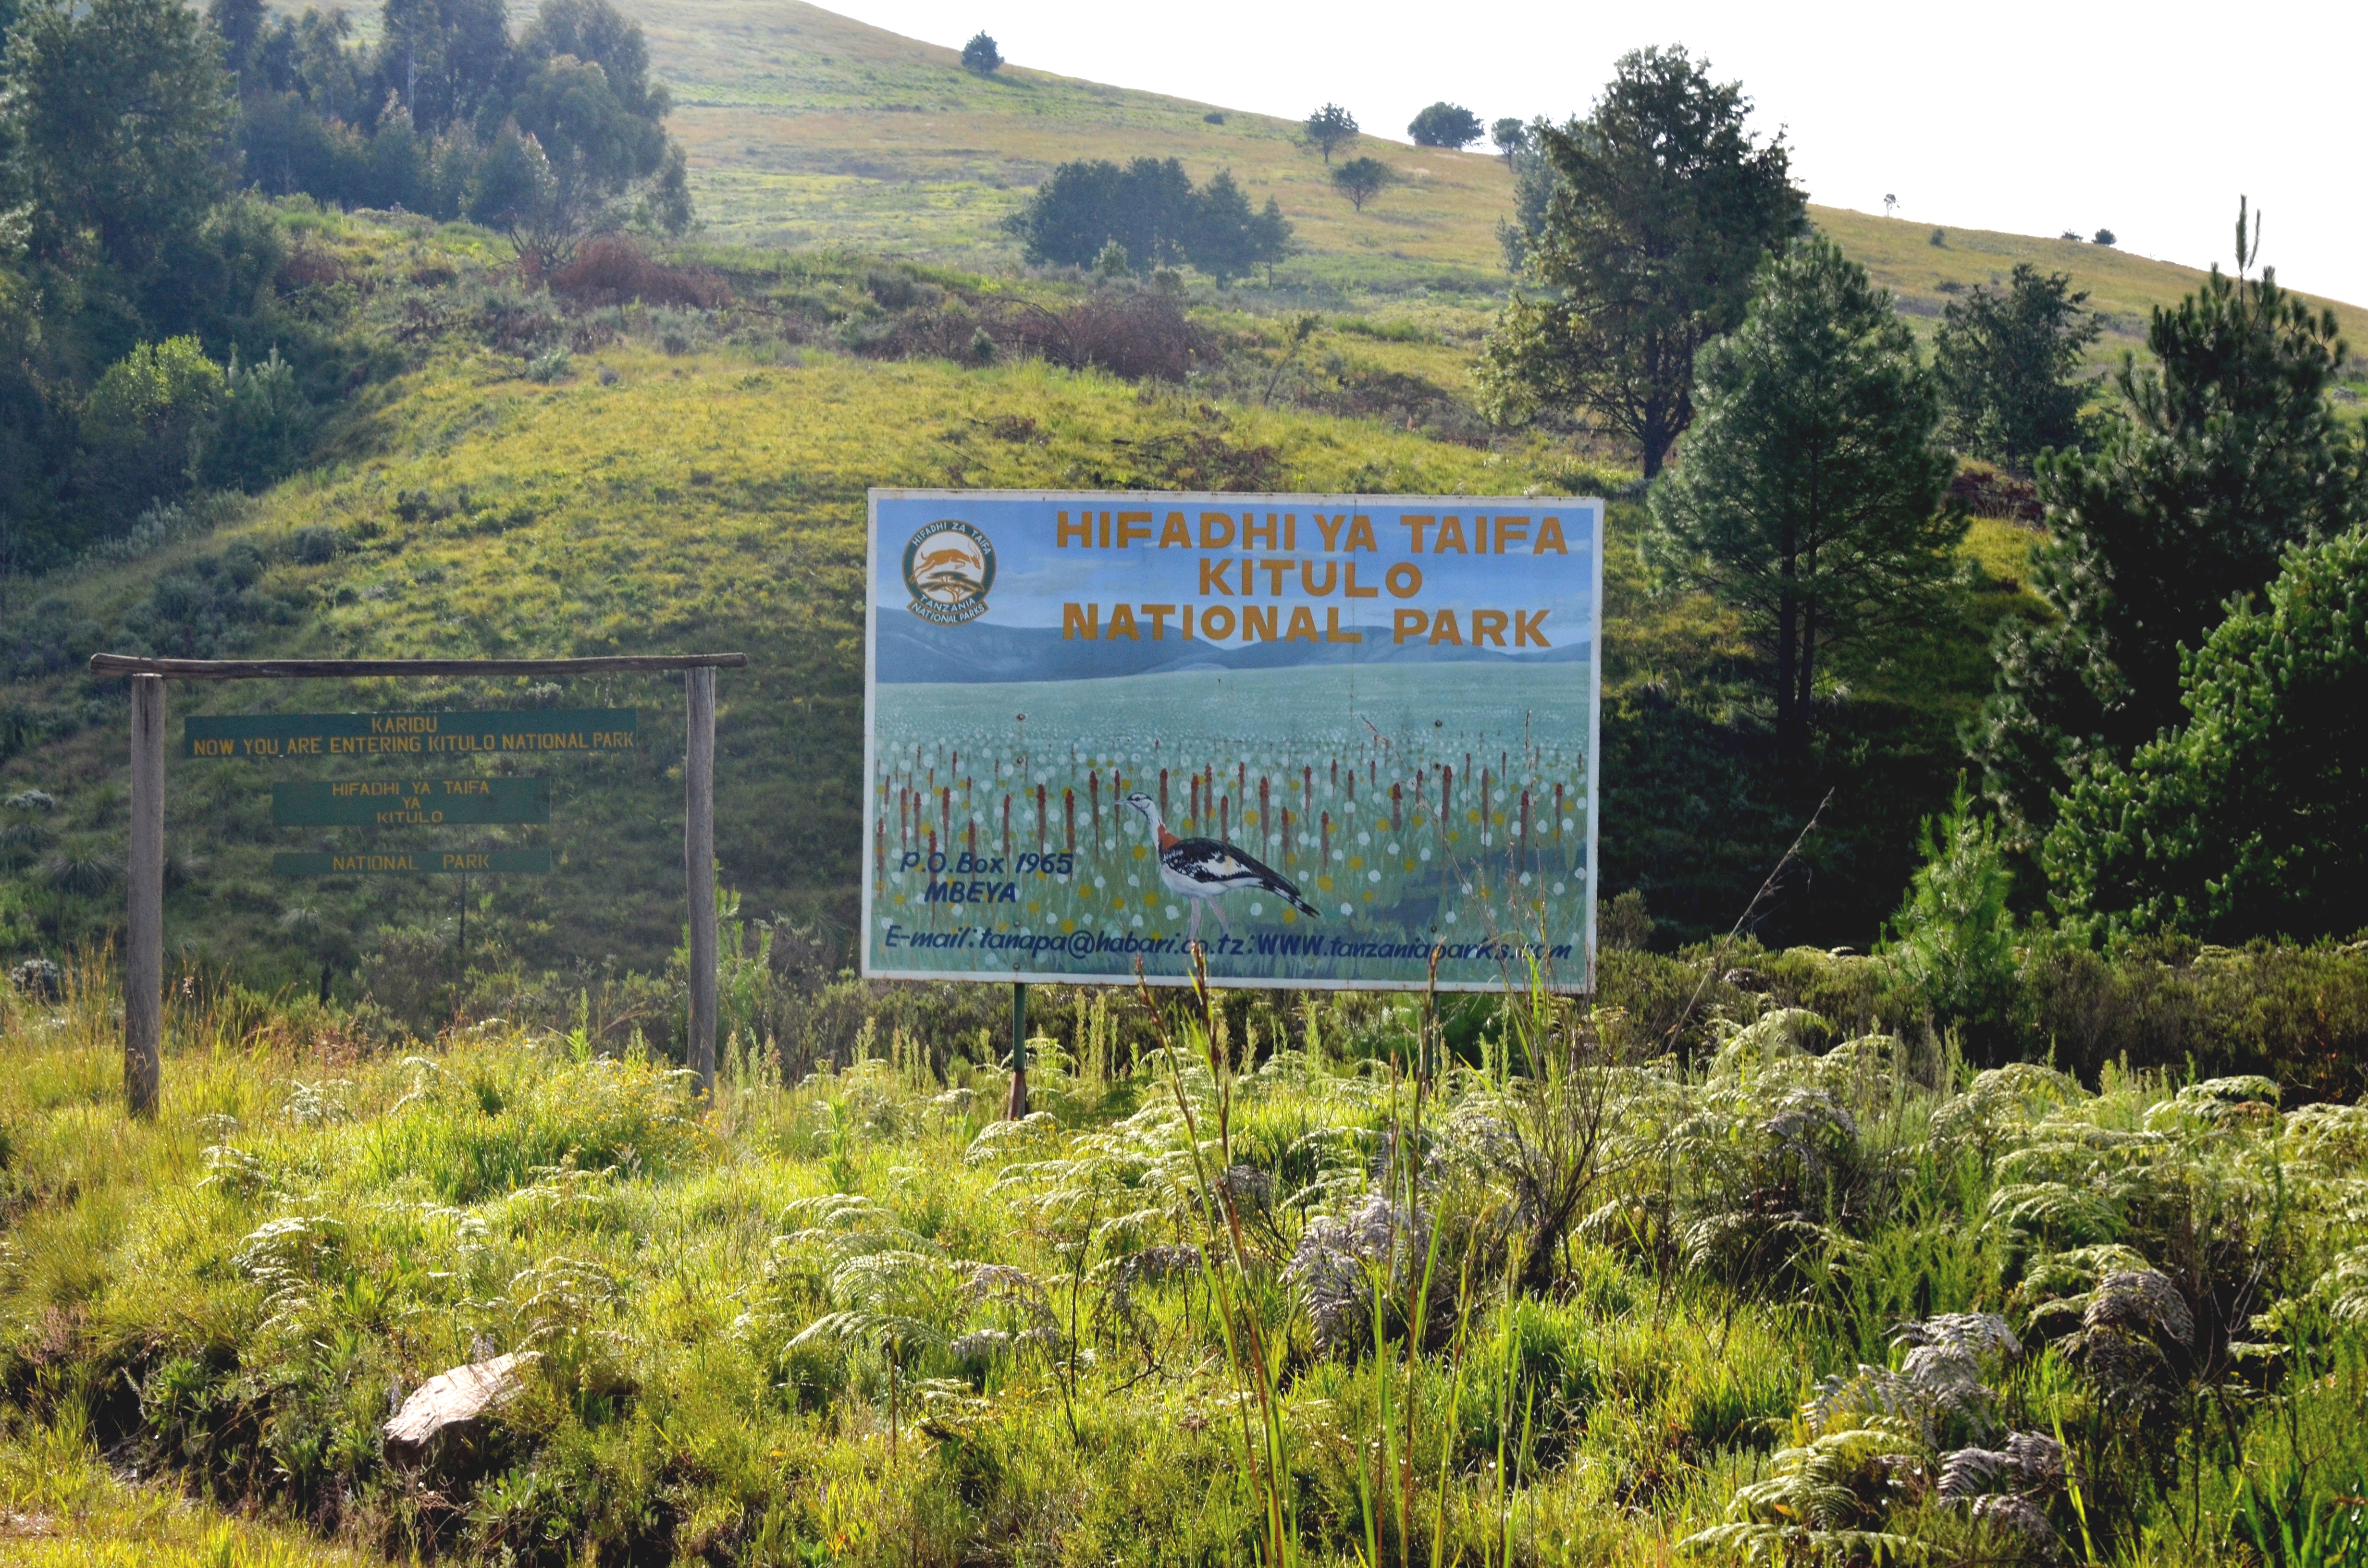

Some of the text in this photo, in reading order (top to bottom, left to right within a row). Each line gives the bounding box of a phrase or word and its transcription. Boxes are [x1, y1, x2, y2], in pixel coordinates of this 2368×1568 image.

[912, 522, 992, 556] HIFADHI ZA TAIFA
[1057, 511, 1568, 555] HIFADHI YA TAIFA
[1199, 558, 1422, 599] KITULO
[911, 602, 985, 624] NATIONAL PARKS
[920, 594, 976, 612] TANZANIA
[1062, 603, 1552, 648] NATIONAL PARK
[371, 716, 438, 733] KARIBU
[194, 731, 634, 756] NOW YOU ARE ENTERING KITULO NATIONAL PARK
[333, 780, 490, 796] HIFADHI YA TAIFA
[402, 796, 421, 809] YA
[377, 811, 444, 823] KITULO
[333, 854, 491, 870] NATIONAL PARK
[925, 882, 1017, 903] MBEYA
